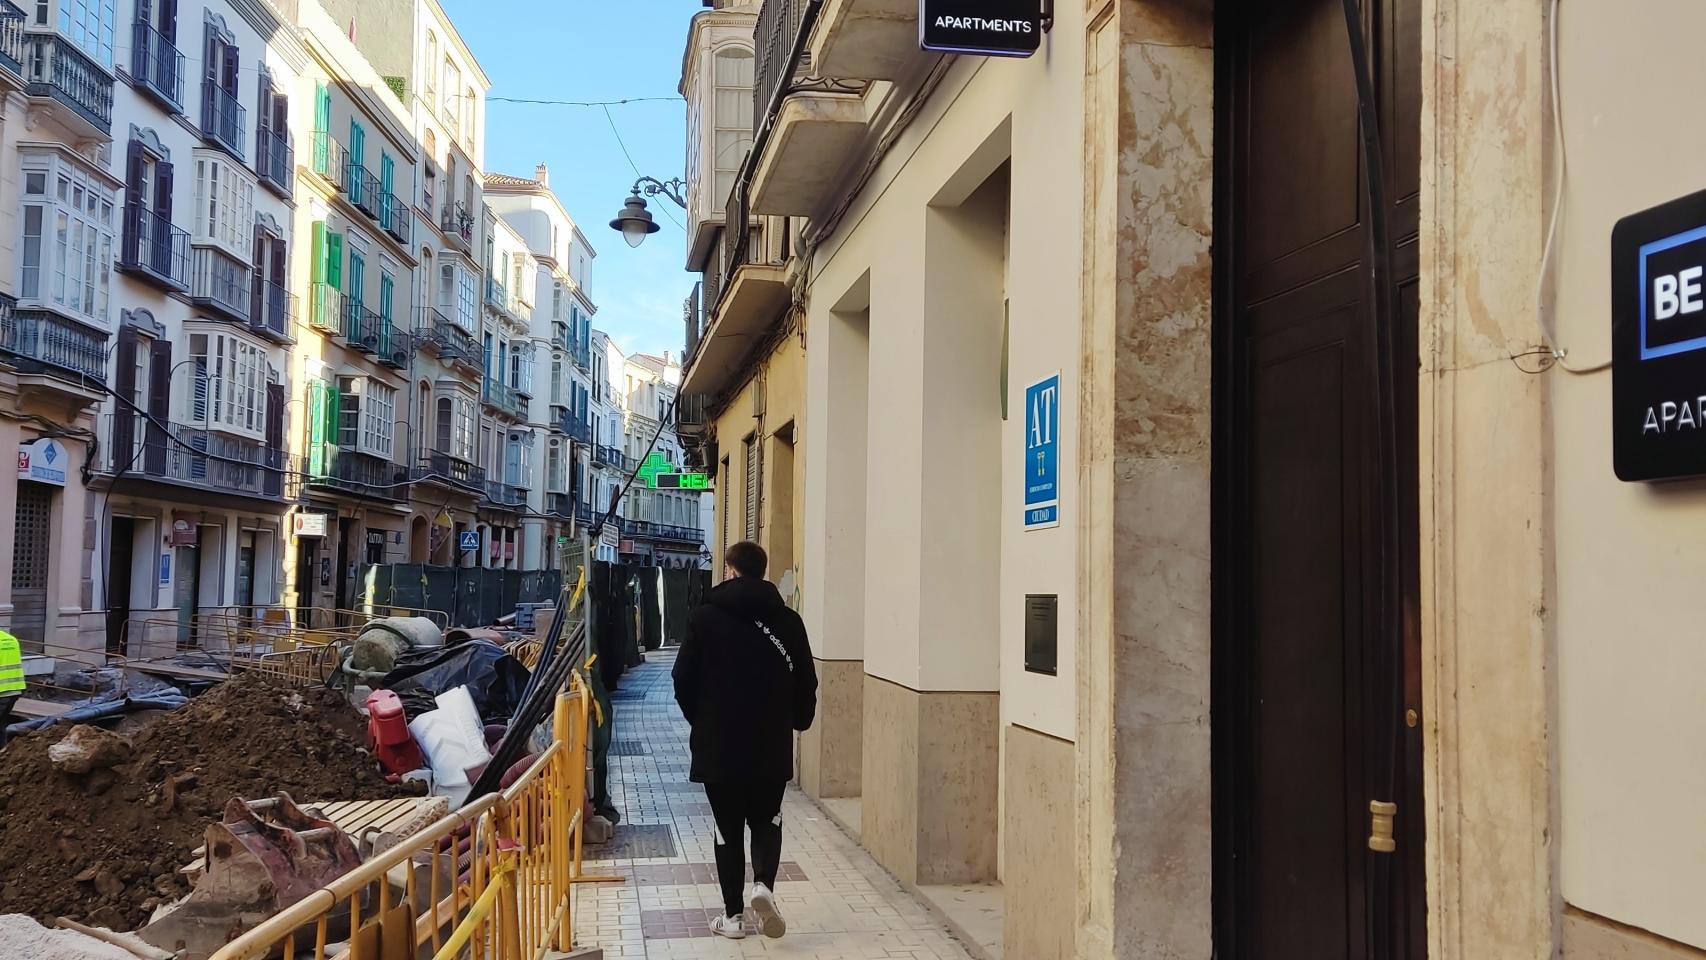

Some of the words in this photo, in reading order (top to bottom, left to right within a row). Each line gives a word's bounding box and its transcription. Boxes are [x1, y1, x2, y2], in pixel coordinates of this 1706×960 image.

[935, 15, 1032, 33] APARTMENTS
[1653, 265, 1704, 320] BE
[1028, 386, 1055, 449] AT
[769, 634, 787, 656] adidas
